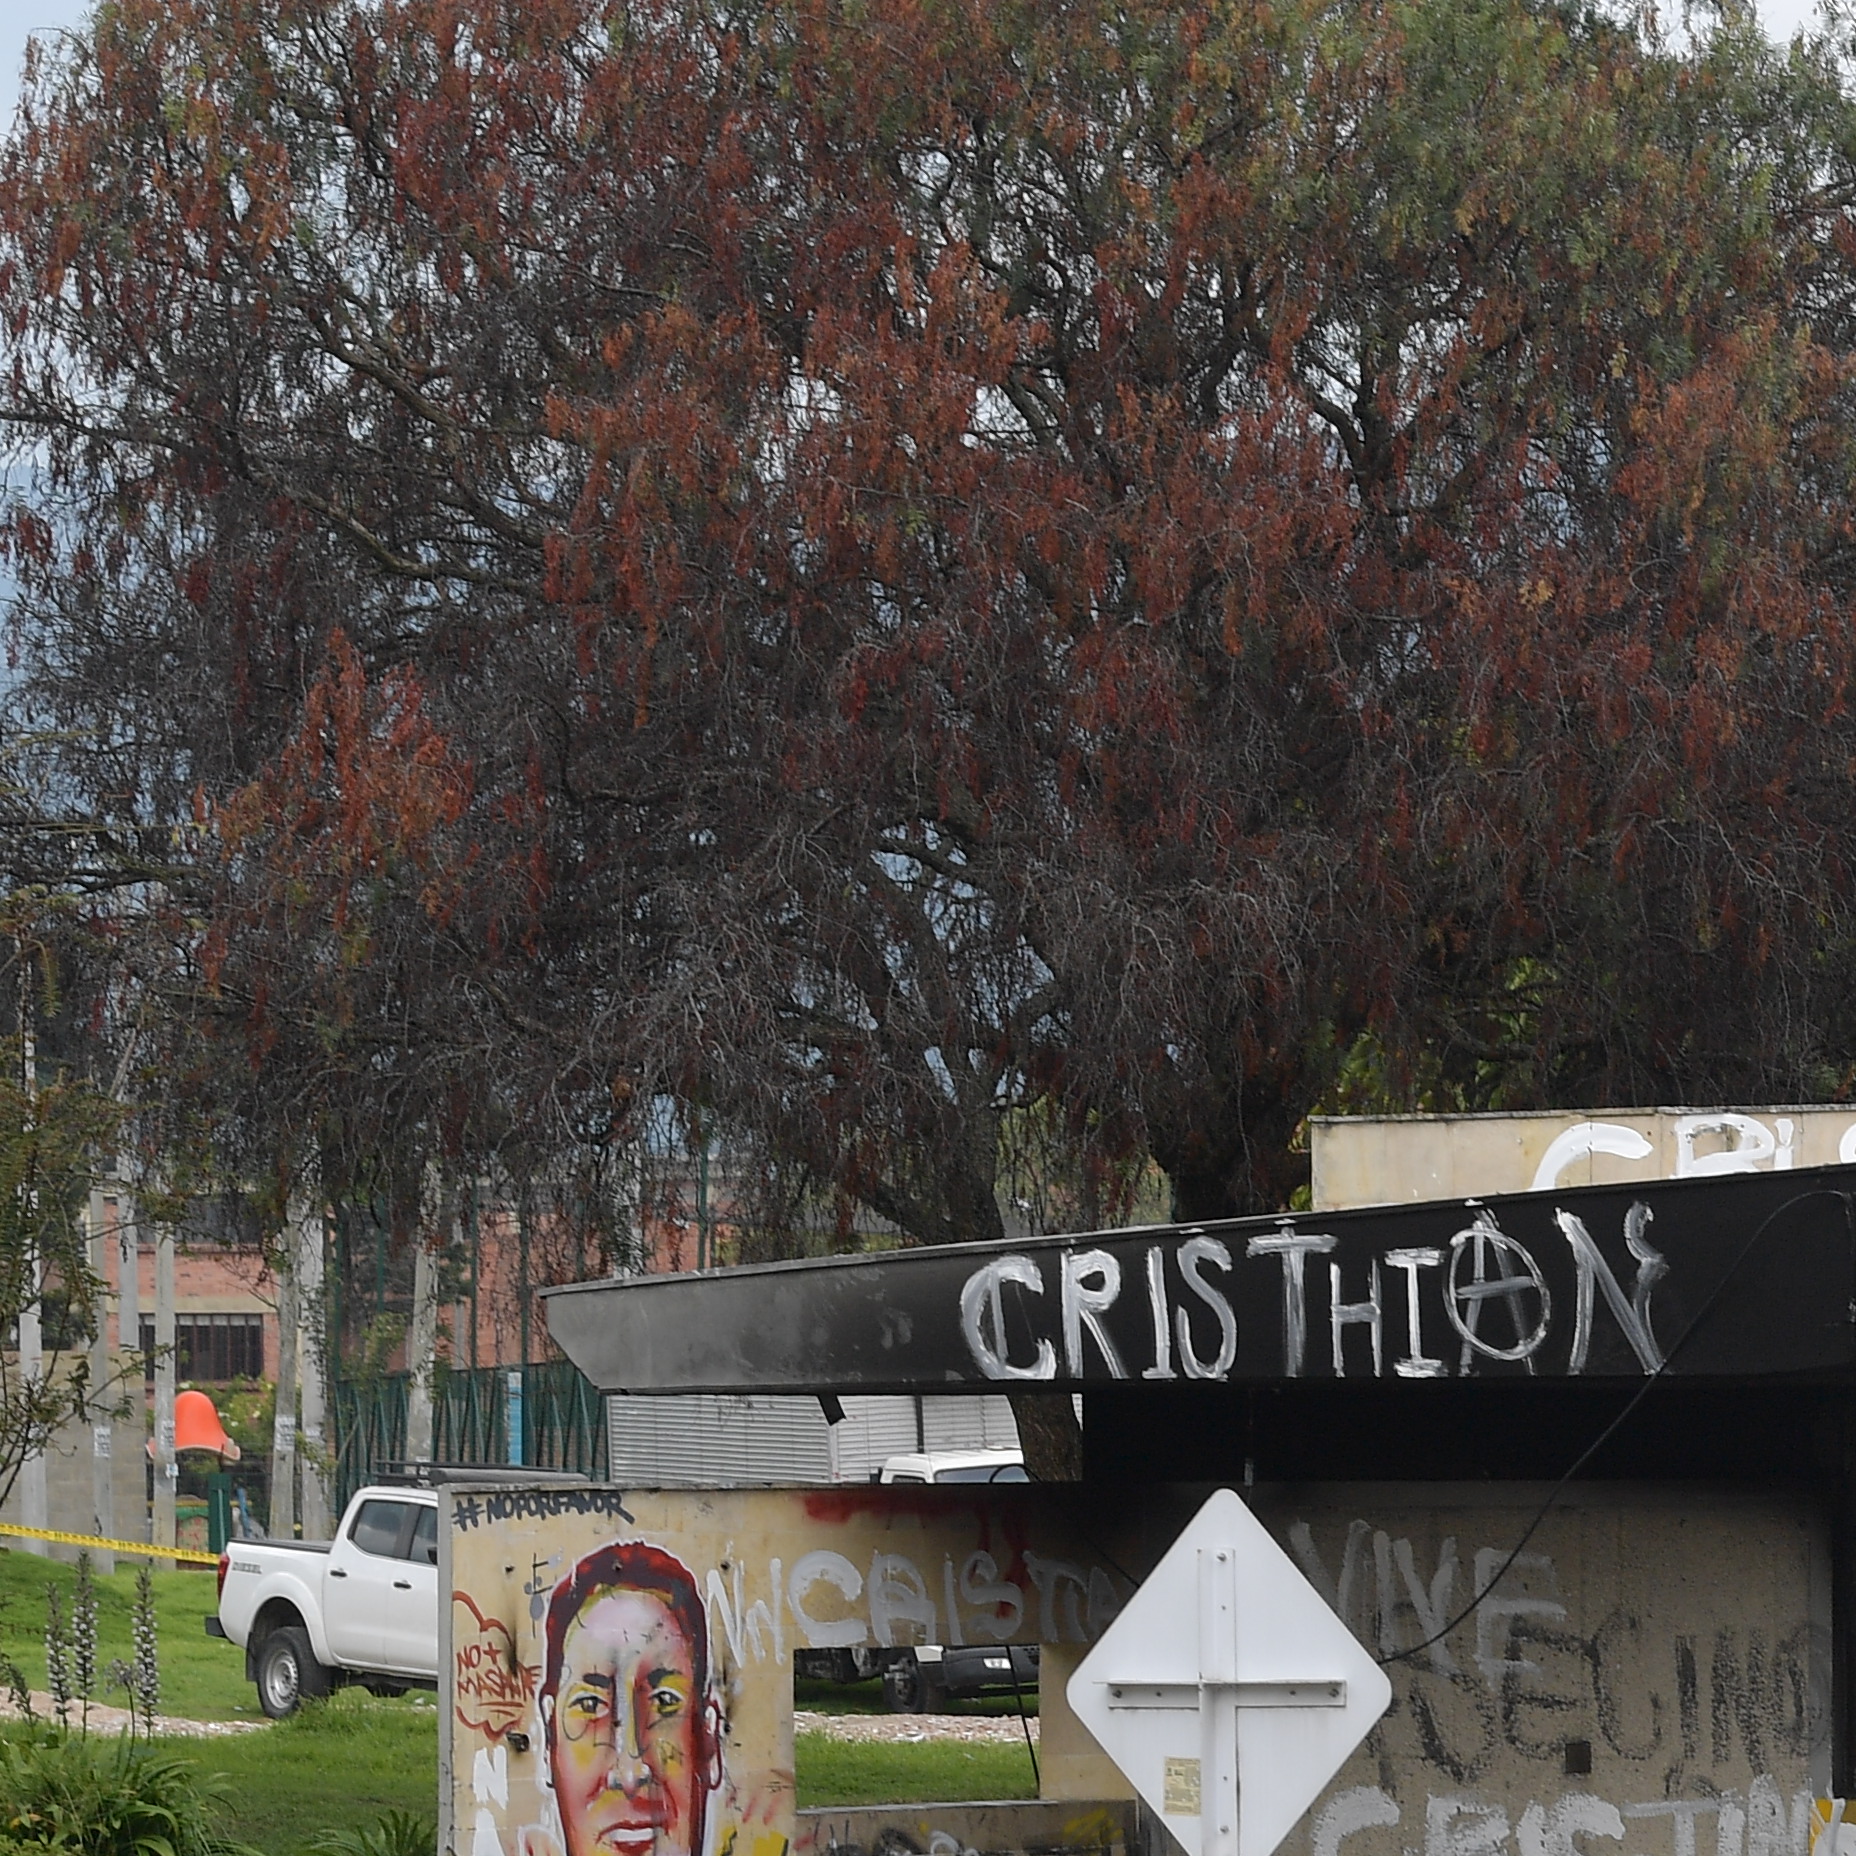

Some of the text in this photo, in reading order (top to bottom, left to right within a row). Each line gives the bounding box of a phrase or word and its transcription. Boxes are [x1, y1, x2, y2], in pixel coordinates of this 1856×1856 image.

[958, 1199, 1674, 1383] CRISTHIAN
[452, 1492, 635, 1532] #NOPORFAVOR
[788, 1549, 1130, 1649] CRISTIA
